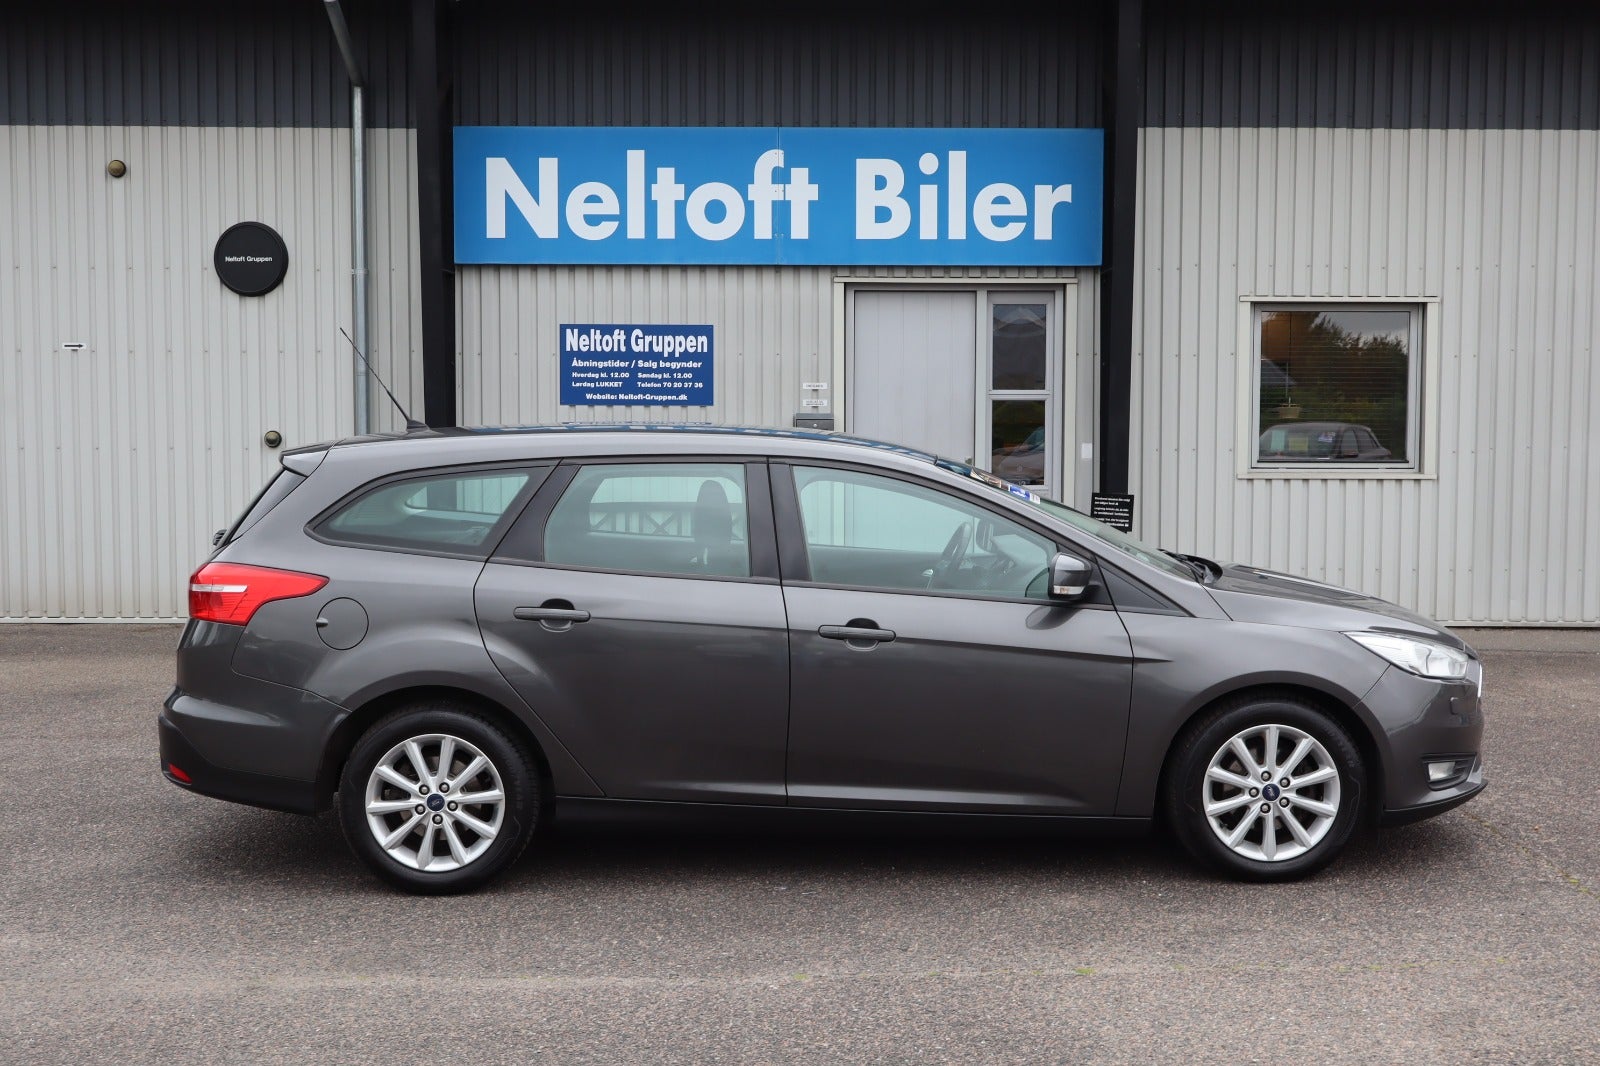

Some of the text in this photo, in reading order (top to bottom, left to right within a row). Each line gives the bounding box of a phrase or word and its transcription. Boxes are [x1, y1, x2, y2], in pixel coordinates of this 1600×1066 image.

[485, 149, 1073, 242] Neltoft Biler
[565, 328, 708, 357] Neltoft Gruppen
[571, 357, 703, 370] Åbningstider / Salg begynder
[571, 371, 599, 379] Hverdag
[618, 393, 688, 402] Neltoft-Gruppen.dk
